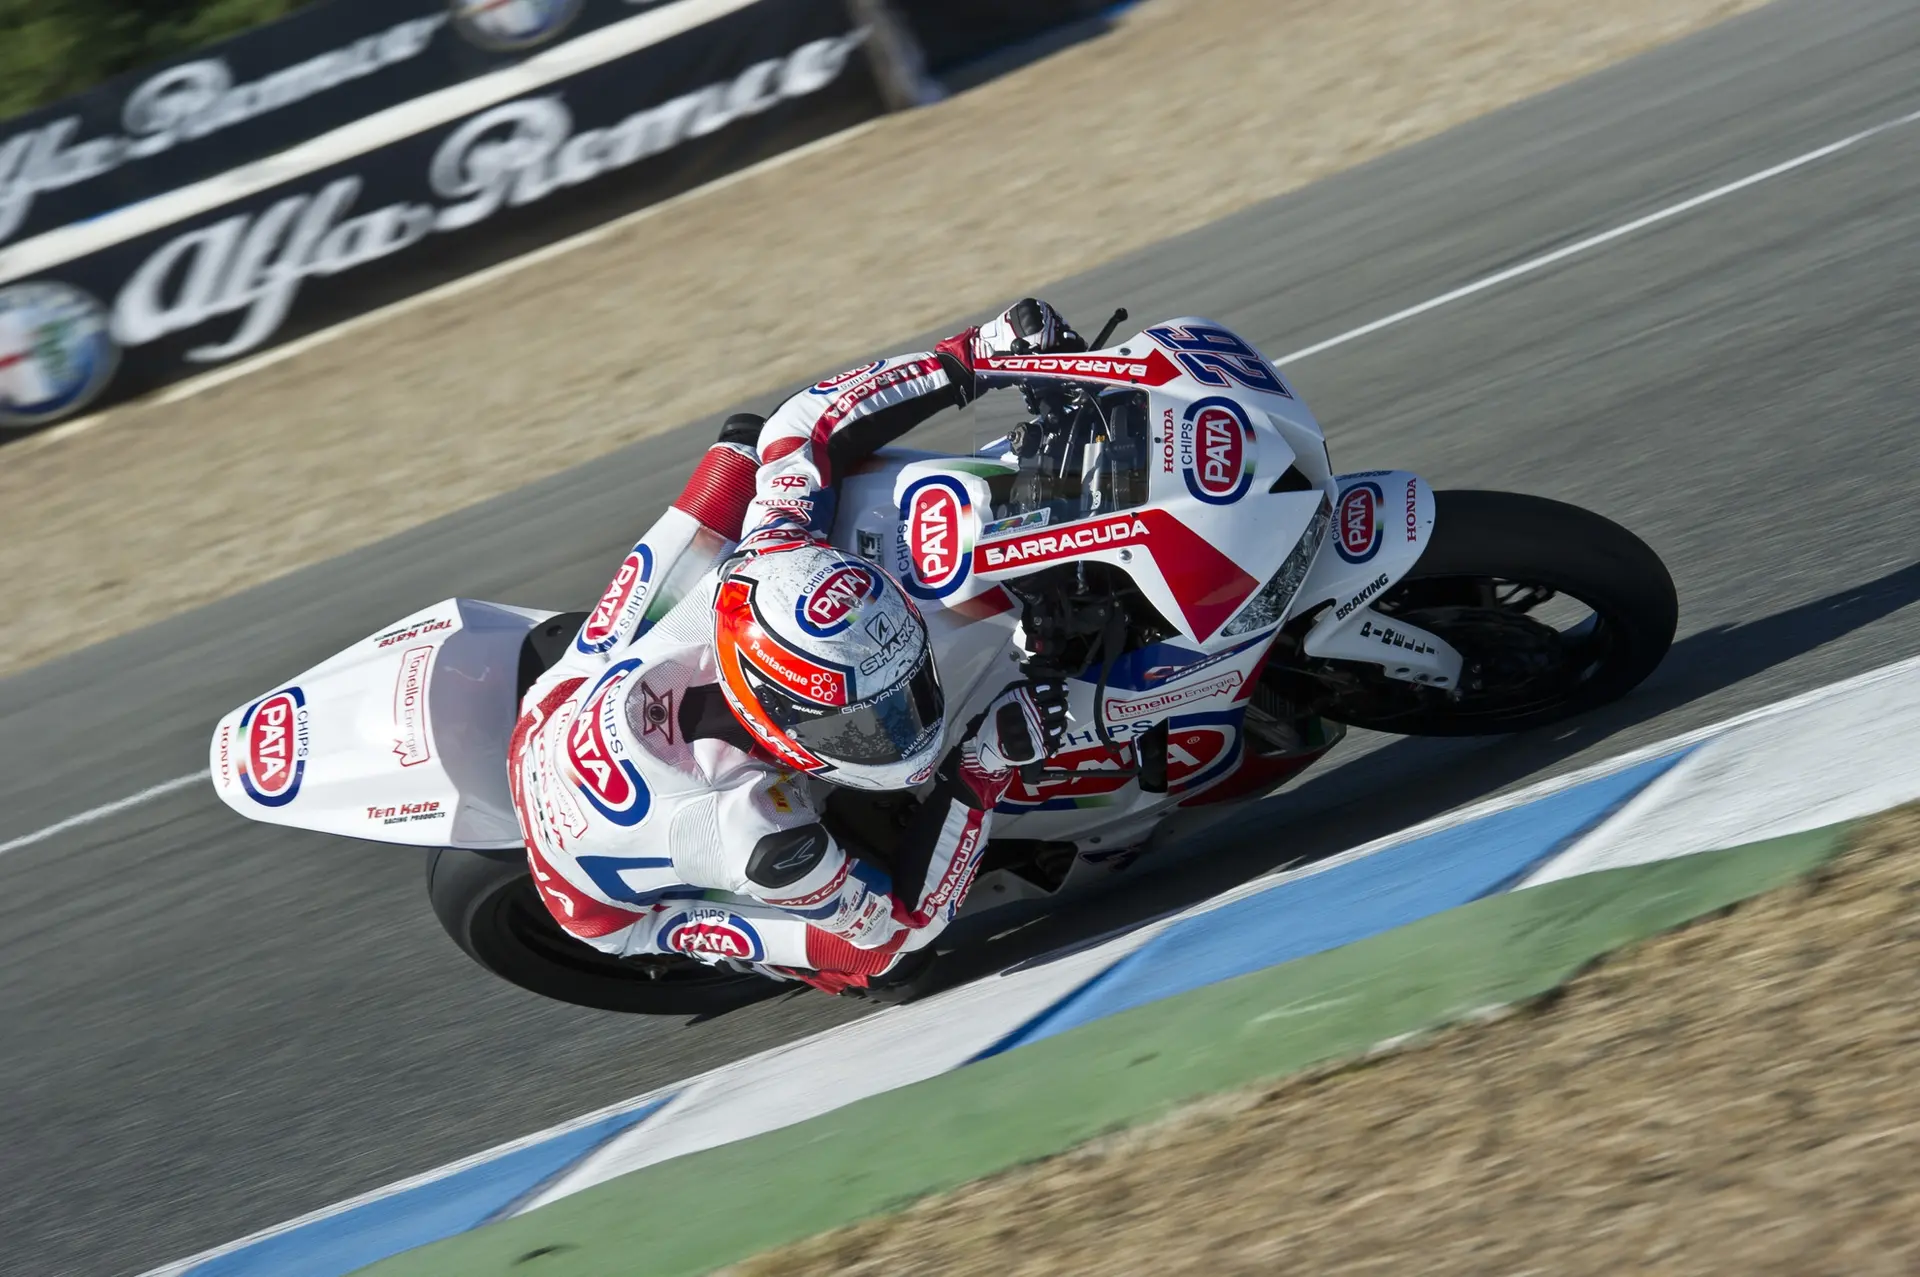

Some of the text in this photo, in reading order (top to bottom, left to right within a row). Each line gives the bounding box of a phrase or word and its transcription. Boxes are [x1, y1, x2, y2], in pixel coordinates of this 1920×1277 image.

[112, 27, 874, 362] Alfa Romeo
[988, 358, 1148, 377] BARRACUDA
[1142, 325, 1294, 400] 26
[1163, 408, 1174, 473] HONDA
[1181, 423, 1193, 466] CHIPS
[1205, 418, 1232, 483] PATA
[1331, 508, 1340, 541] CHIPS
[1348, 493, 1368, 546] PATA
[1406, 478, 1417, 543] HONDA
[896, 523, 910, 572] CHIPS
[921, 497, 949, 579] PATA
[985, 519, 1150, 567] BARRACUDA
[587, 564, 636, 629] PATA
[802, 566, 834, 596] CHIPS
[812, 574, 866, 620] PATA
[1335, 572, 1390, 622] BRAKING
[424, 618, 453, 633] Ten
[618, 585, 647, 630] CHIPS
[860, 614, 916, 677] SHARK
[1359, 621, 1436, 655] PIRELLI
[404, 652, 426, 707] Tonello
[751, 640, 809, 686] Pentacque
[604, 682, 624, 755] CHIPS
[791, 704, 826, 716] SHARK
[1113, 694, 1183, 715] Tonello
[1184, 676, 1236, 698] Energie
[219, 725, 232, 788] HONDA
[259, 704, 288, 782] PATA
[297, 711, 310, 758] CHIPS
[572, 700, 612, 793] ATA
[1057, 719, 1153, 748] HIPS
[366, 801, 440, 820] Ten Kate
[923, 828, 980, 918] BARRACUDA
[952, 869, 970, 899] CHIPS
[679, 931, 742, 955] PATA
